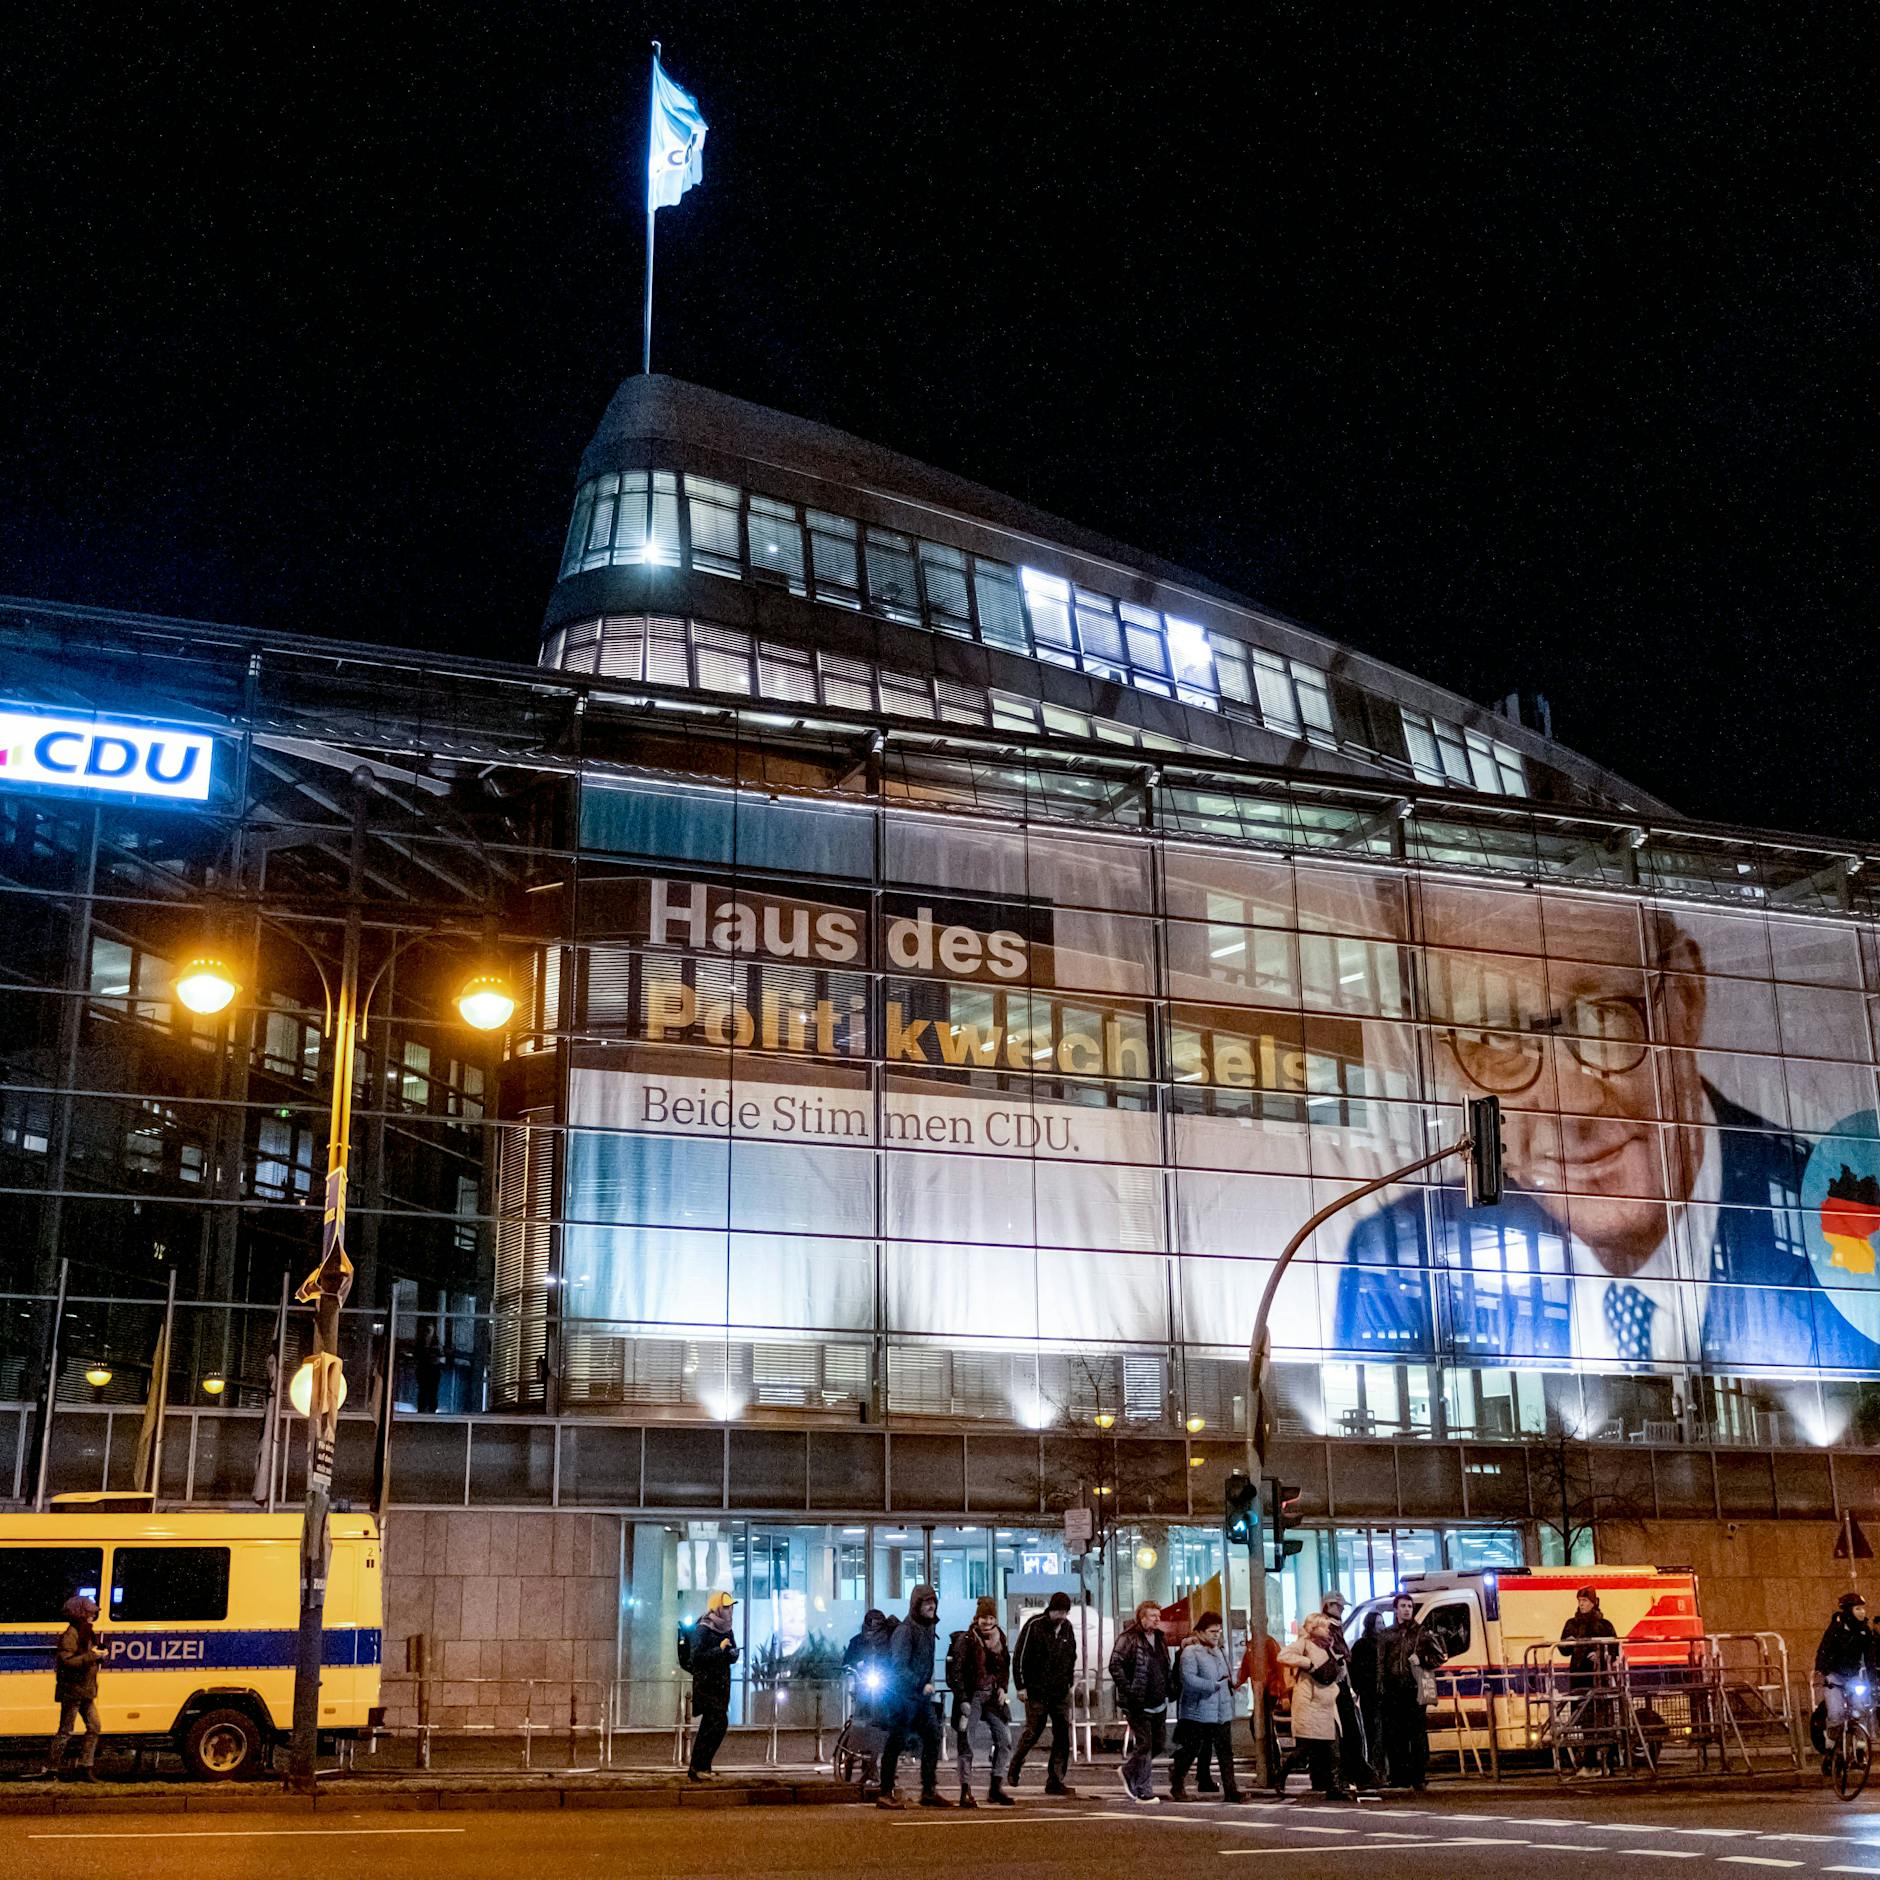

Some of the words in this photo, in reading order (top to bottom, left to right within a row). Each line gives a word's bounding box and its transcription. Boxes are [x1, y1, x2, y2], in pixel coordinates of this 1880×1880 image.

[34, 731, 201, 785] CDU
[649, 878, 859, 962] Haus
[887, 907, 1029, 979] des
[641, 1086, 761, 1130] Beide
[772, 1095, 973, 1145] Stimmen
[985, 1111, 1081, 1153] CDU.
[368, 1547, 374, 1557] 2
[110, 1640, 205, 1661] POLIZEI
